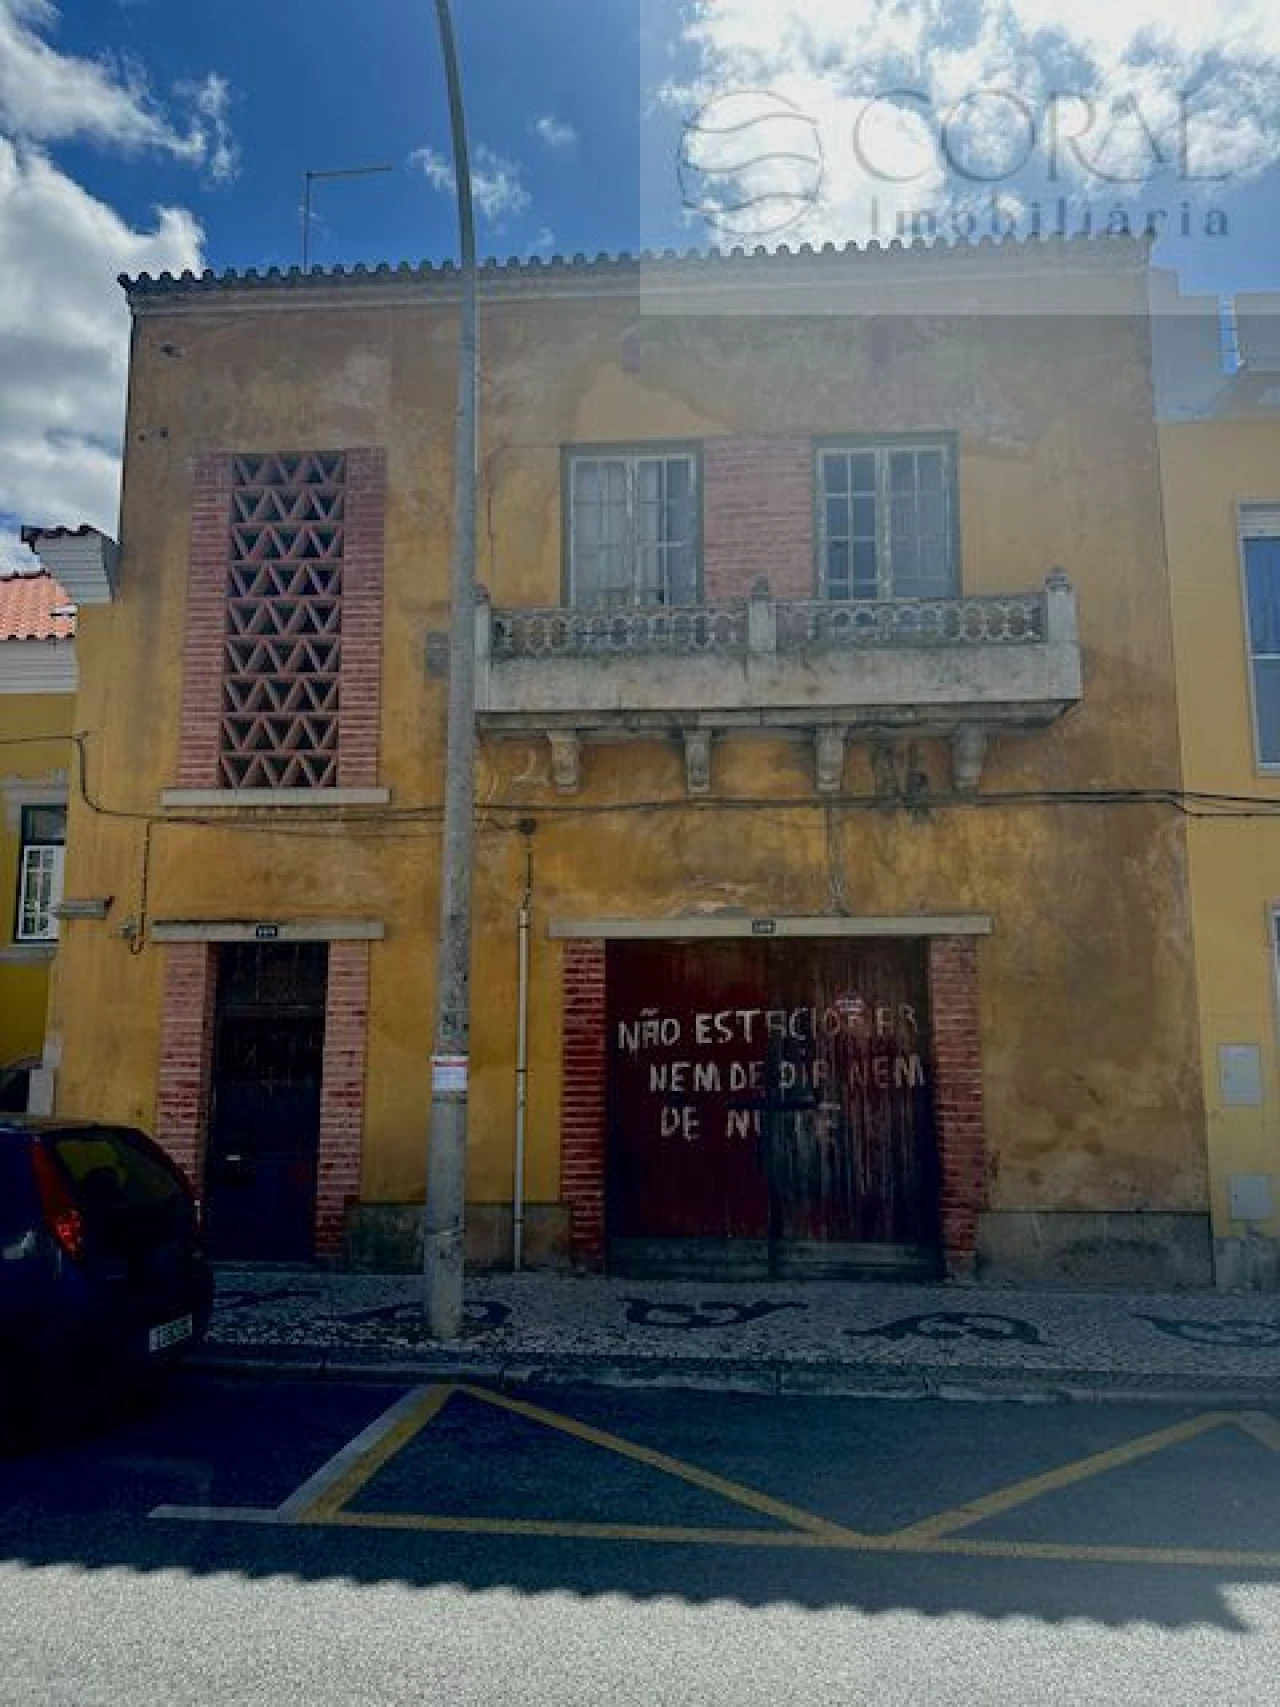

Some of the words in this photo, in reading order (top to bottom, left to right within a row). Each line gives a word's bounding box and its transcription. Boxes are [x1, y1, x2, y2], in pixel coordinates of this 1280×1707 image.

[618, 1008, 681, 1053] NÃO
[650, 1061, 721, 1092] NEM
[730, 1061, 766, 1092] DE
[851, 1054, 925, 1089] NEM
[660, 1106, 700, 1141] DE
